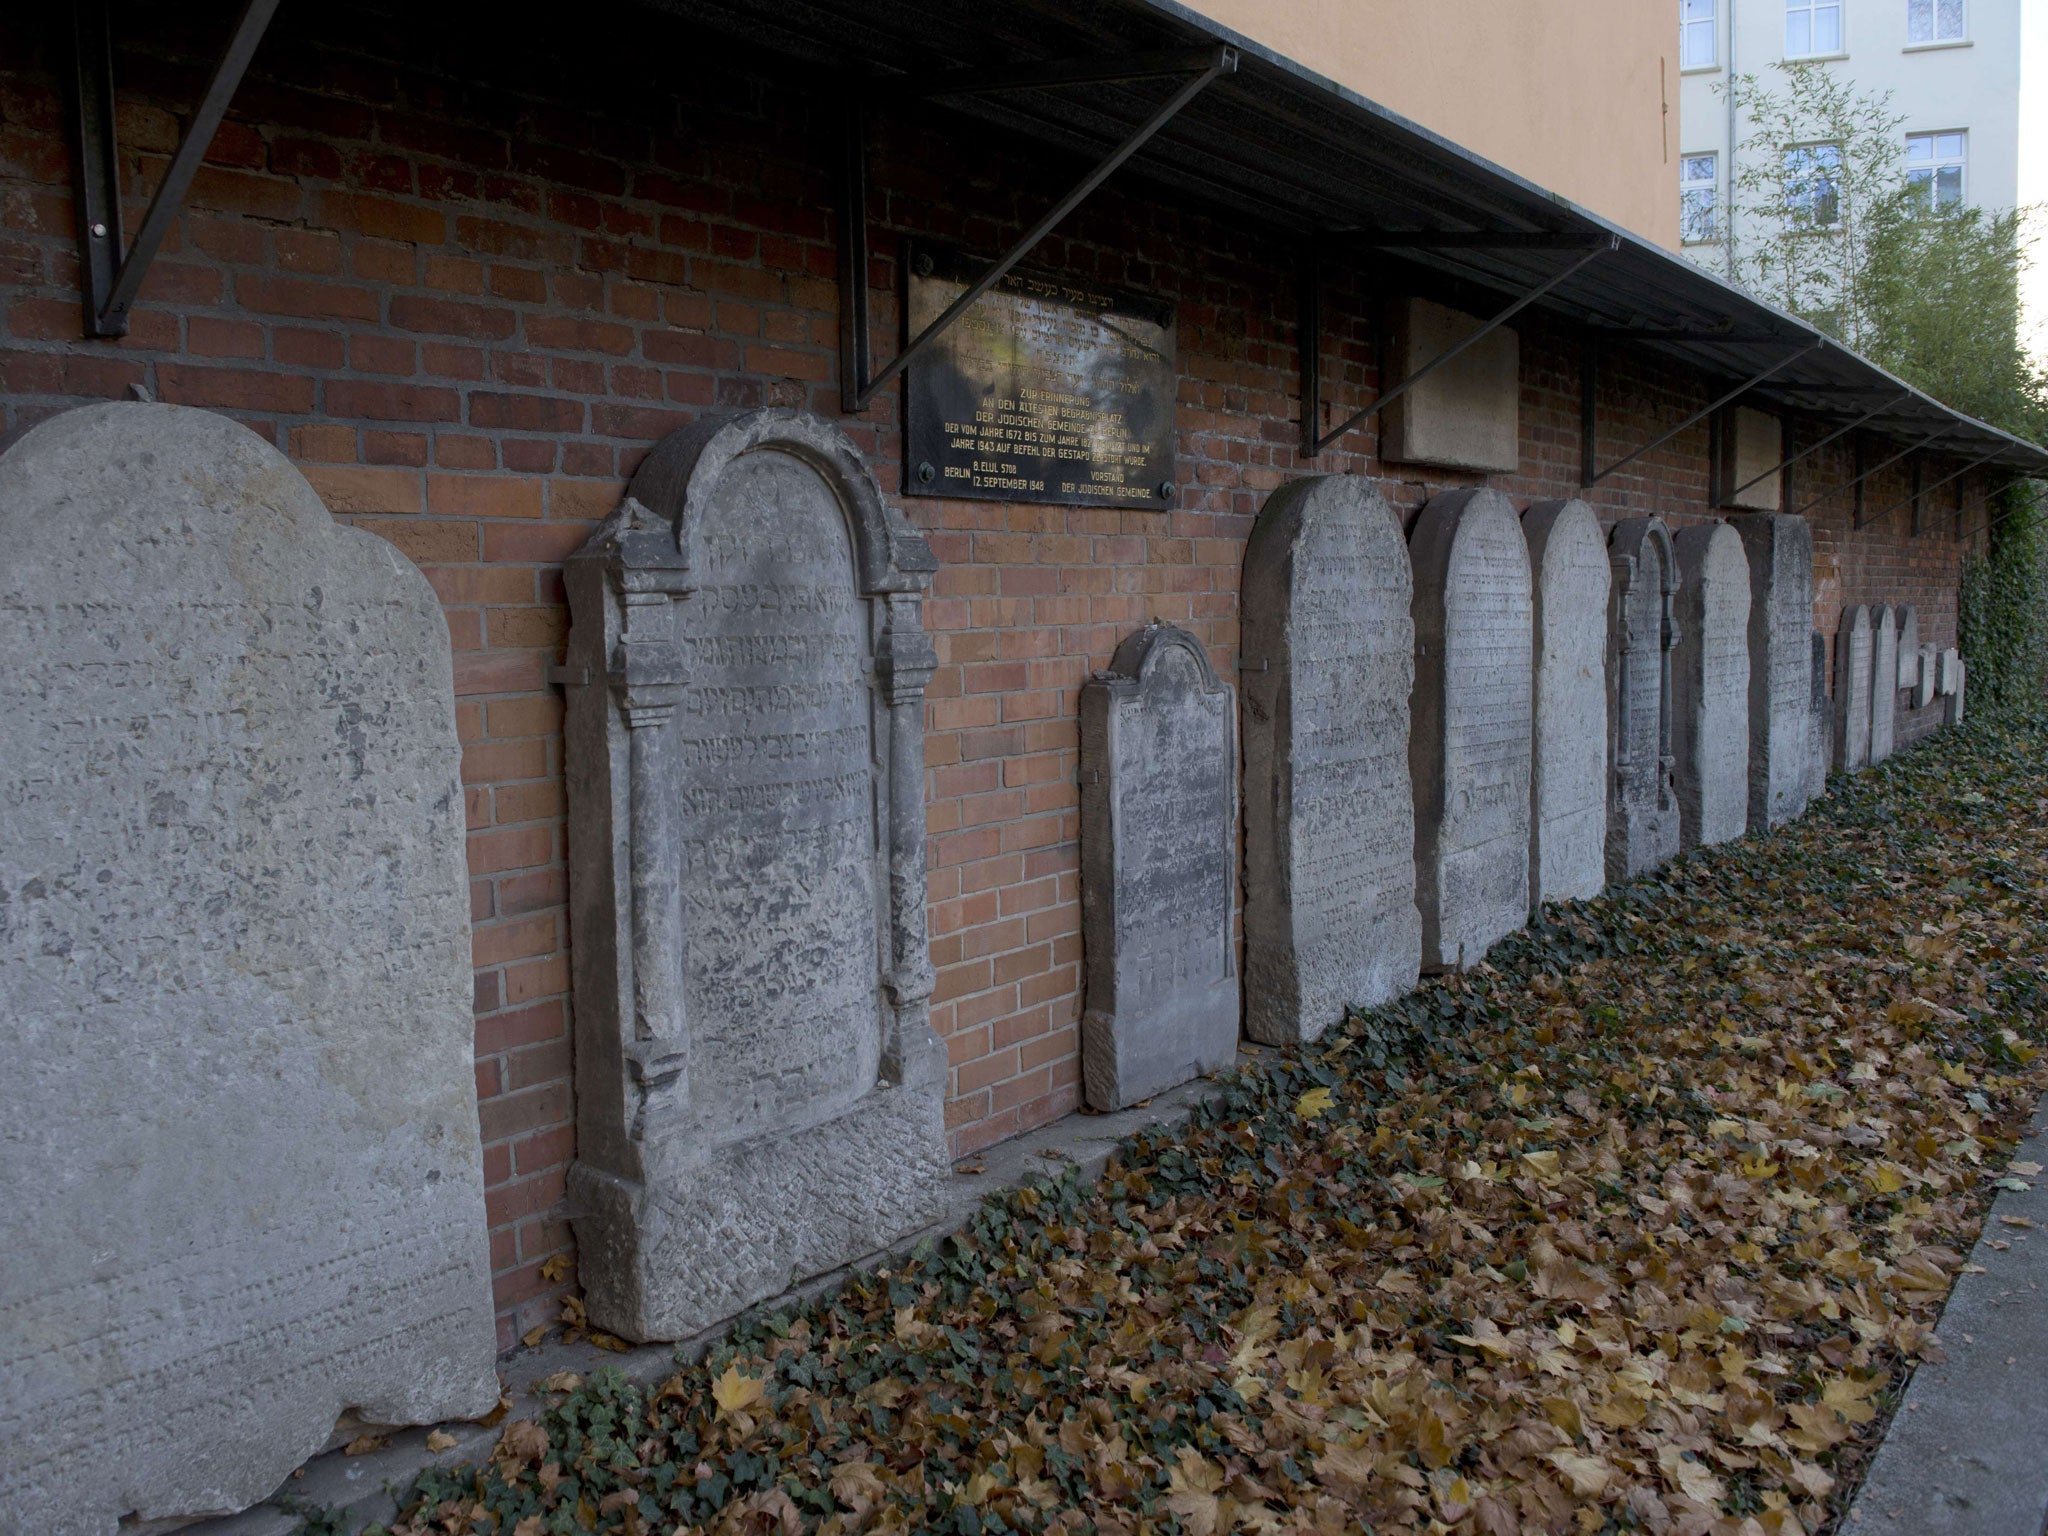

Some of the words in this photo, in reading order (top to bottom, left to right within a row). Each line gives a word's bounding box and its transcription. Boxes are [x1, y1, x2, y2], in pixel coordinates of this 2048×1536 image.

[982, 397, 995, 409] AN
[998, 399, 1015, 411] DEN
[1020, 388, 1038, 400] ZUR
[1041, 391, 1090, 407] ERINNERUNG
[975, 411, 994, 423] DER
[1047, 420, 1086, 434] GEMEINDE
[944, 422, 959, 434] DER
[961, 424, 977, 436] VOM
[979, 426, 1004, 439] JAHRE
[1005, 428, 1022, 441] 1672
[1024, 431, 1037, 442] BIS
[1039, 432, 1056, 444] ZUM
[1057, 435, 1079, 447] JAHRE
[1127, 443, 1140, 453] UND
[950, 437, 976, 450] JAHRE
[977, 440, 995, 452] 1943
[996, 442, 1012, 454] AUF
[1013, 444, 1041, 457] BEFEHL
[1042, 446, 1056, 458] DER
[1058, 448, 1090, 461] GESTAPO
[944, 466, 971, 479] BERLIN
[1001, 464, 1017, 474] 5708
[1090, 470, 1125, 483] VORSTAND
[1029, 479, 1045, 492] 1948
[1061, 482, 1076, 494] DER
